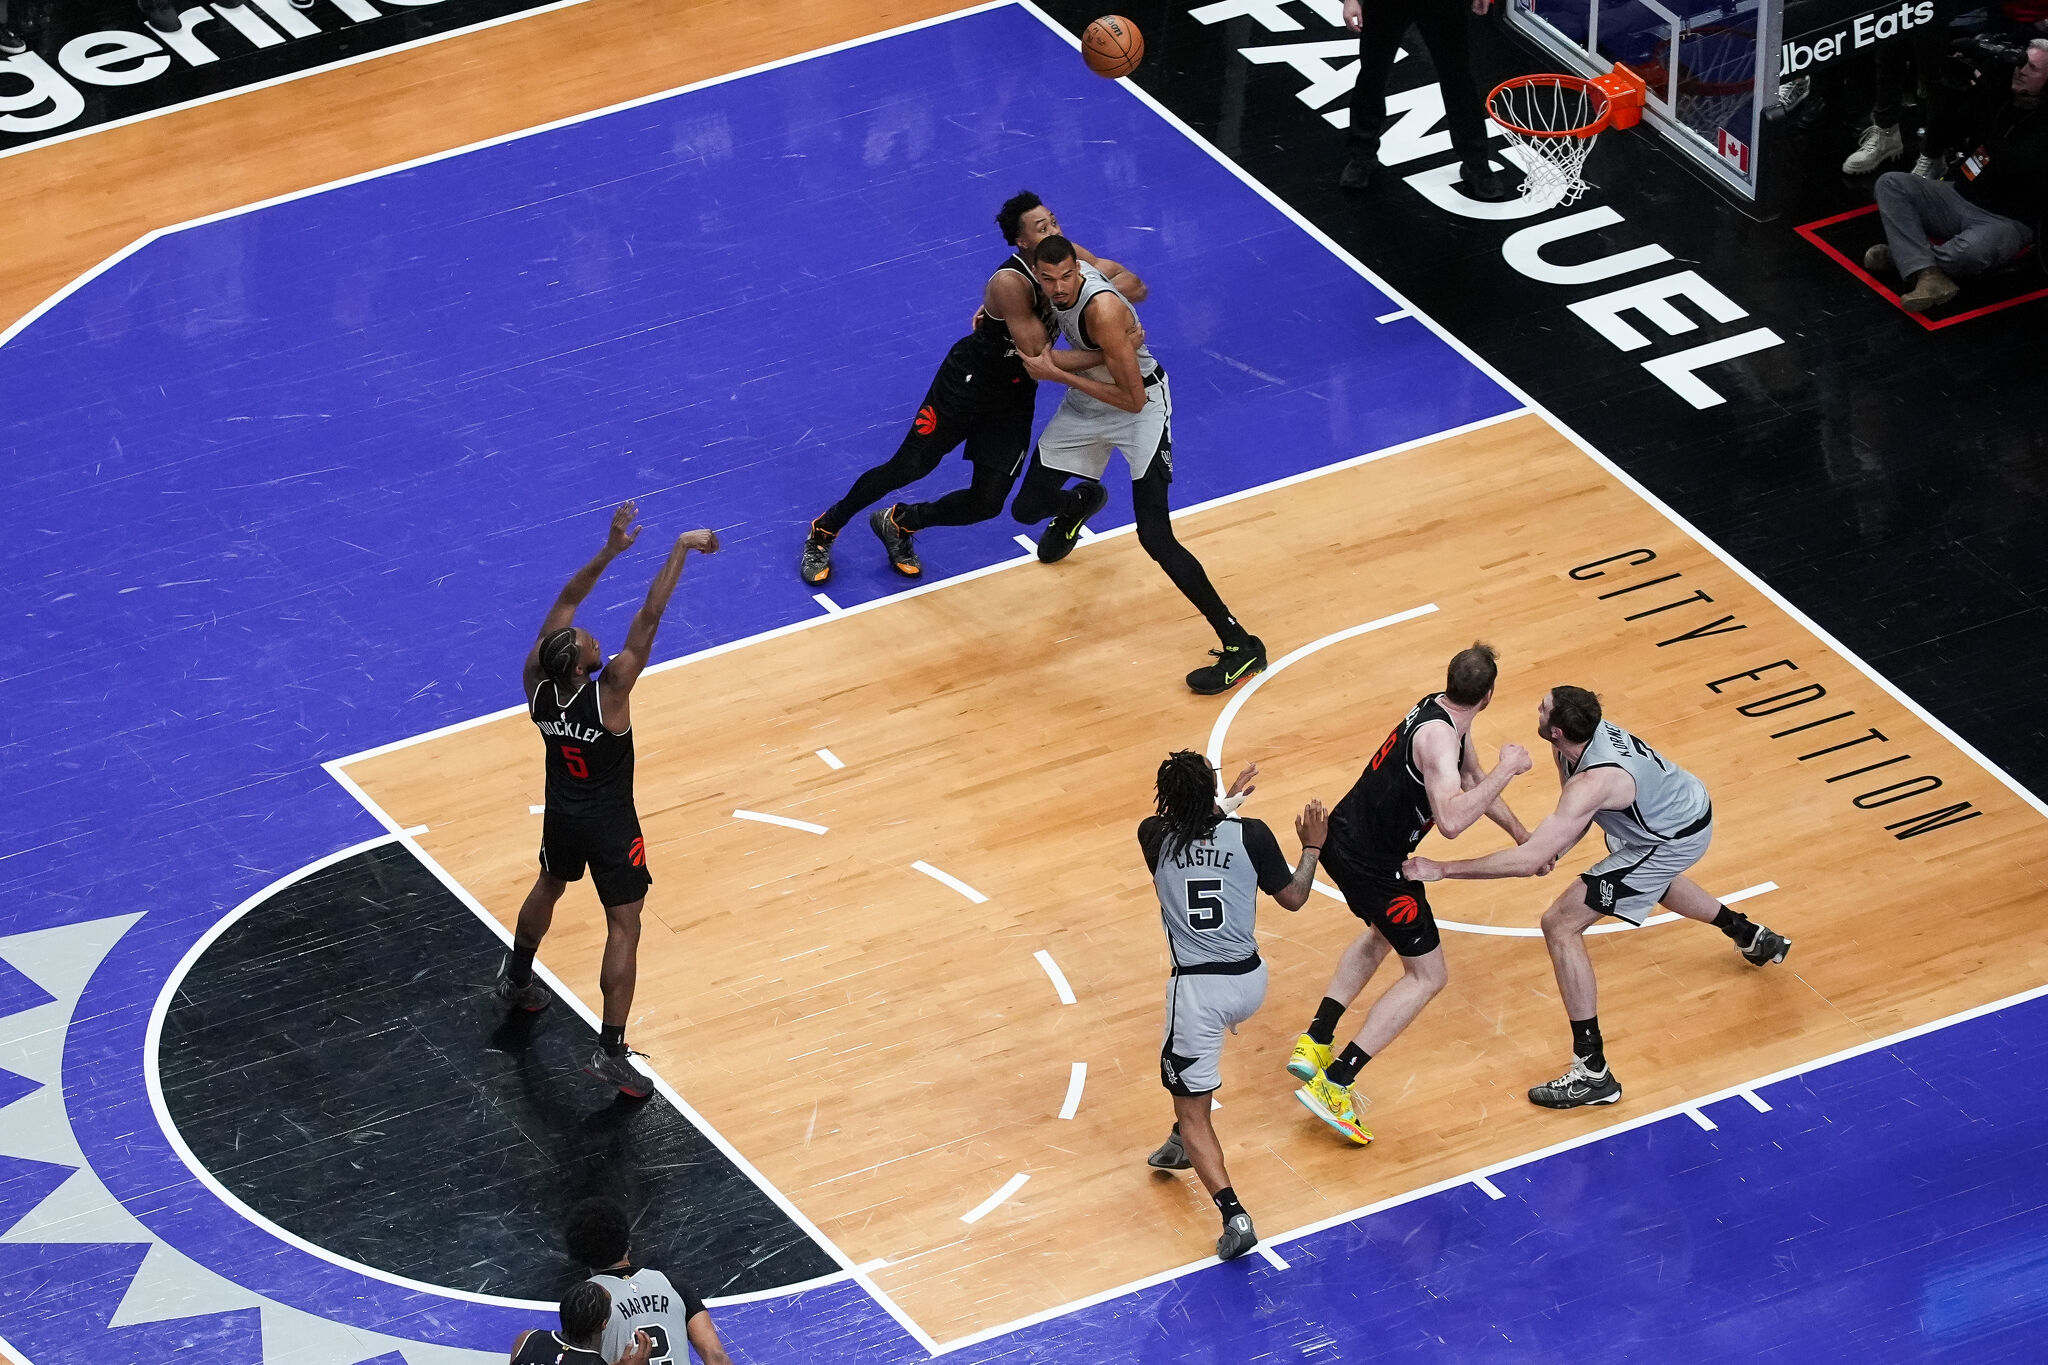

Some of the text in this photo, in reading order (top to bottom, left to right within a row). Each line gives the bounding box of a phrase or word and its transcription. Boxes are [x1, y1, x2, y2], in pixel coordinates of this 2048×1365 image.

[1854, 1, 1935, 49] Eats
[1568, 548, 1984, 841] CITY EDITION
[1603, 720, 1633, 758] KORNE
[561, 745, 589, 779] 5
[1174, 848, 1234, 870] CASTLE
[1185, 877, 1226, 933] 5
[616, 1294, 669, 1321] HARPER
